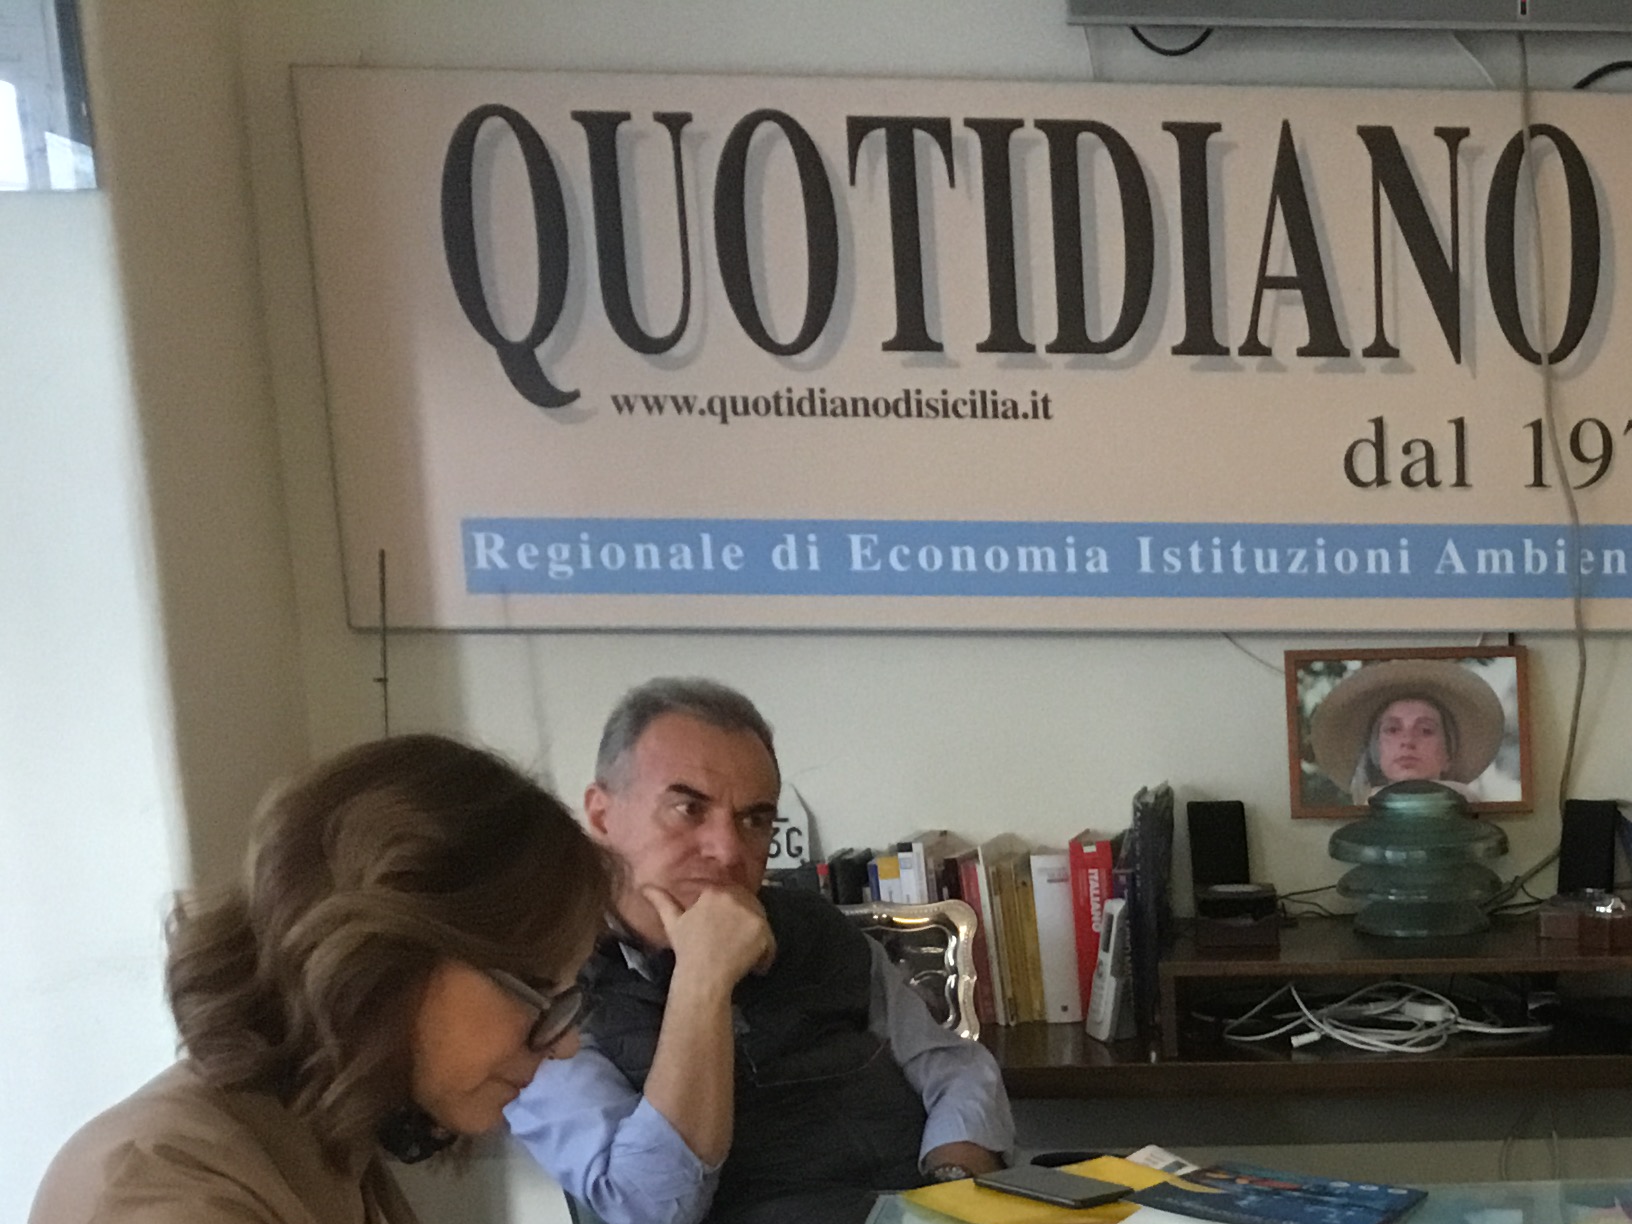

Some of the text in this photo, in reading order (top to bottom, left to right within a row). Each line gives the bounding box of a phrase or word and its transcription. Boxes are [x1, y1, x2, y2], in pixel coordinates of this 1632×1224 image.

[440, 103, 1601, 408] QUOTIDIANO
[610, 389, 1054, 423] www.quotidianodisicilia.it
[1342, 416, 1474, 489] dal
[471, 532, 746, 581] Regionale
[771, 534, 821, 572] di
[848, 536, 1112, 574] Economia
[1136, 536, 1412, 575] Istituzioni
[1086, 868, 1101, 933] ITALIANO
